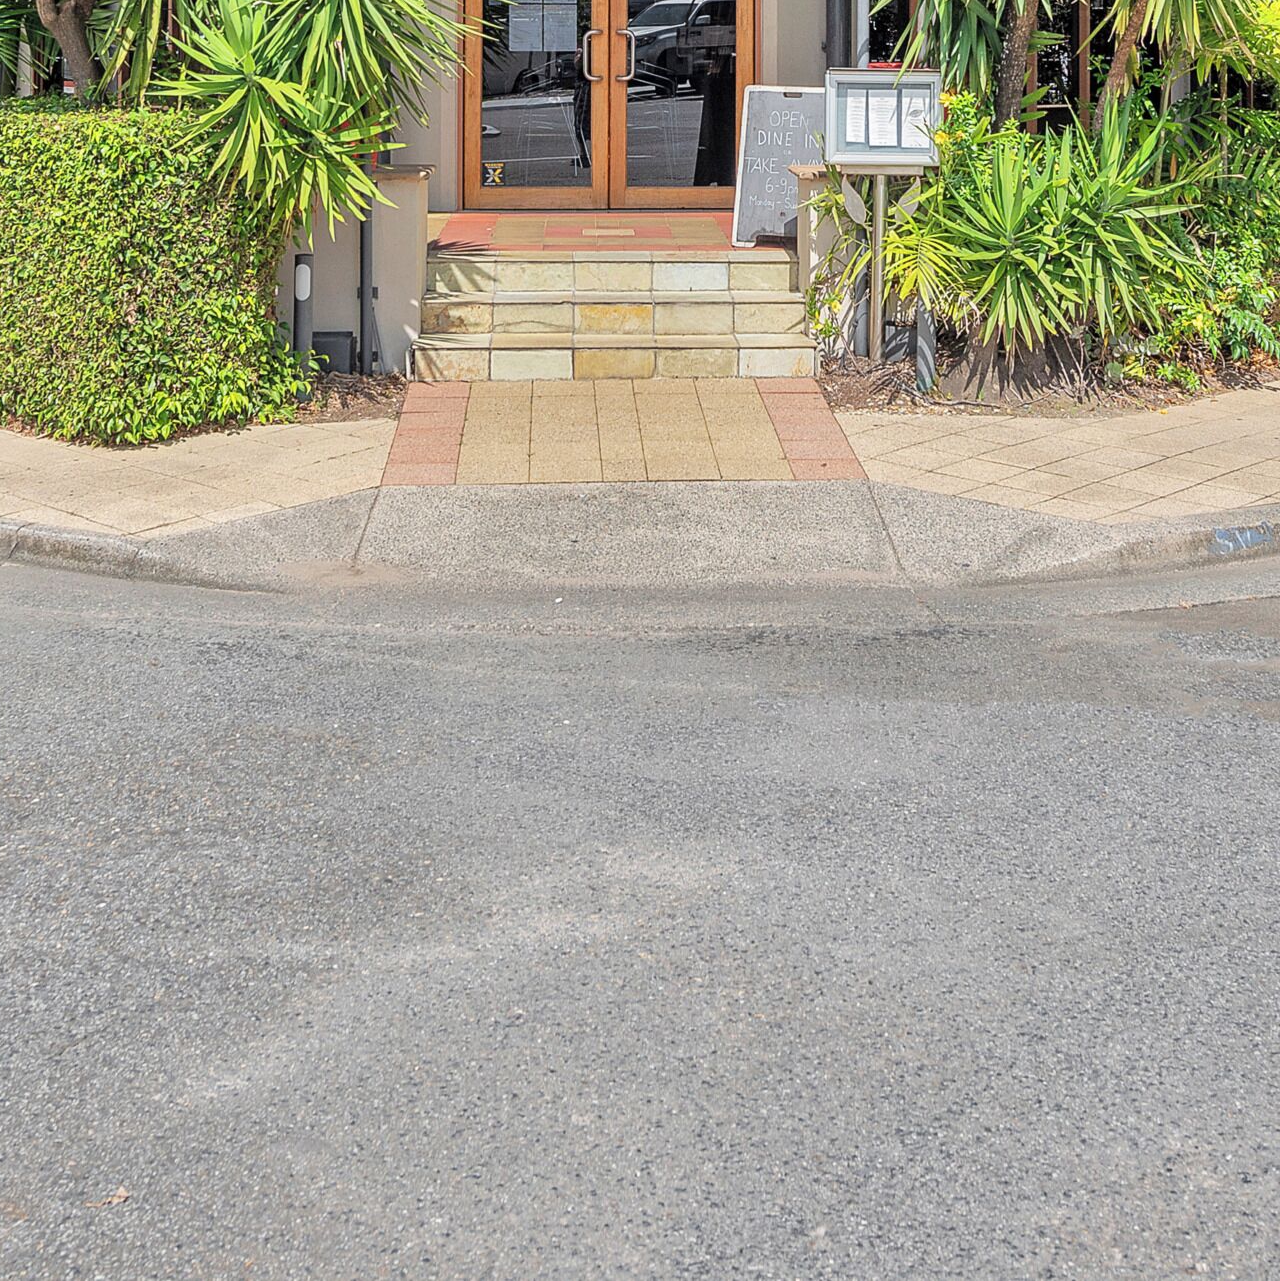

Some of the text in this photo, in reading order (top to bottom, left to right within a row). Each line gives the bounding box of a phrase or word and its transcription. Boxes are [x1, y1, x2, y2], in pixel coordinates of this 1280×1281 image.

[769, 110, 809, 133] OPEN
[757, 129, 820, 149] DINE IN
[744, 157, 780, 174] TAKE
[749, 194, 775, 211] Monday
